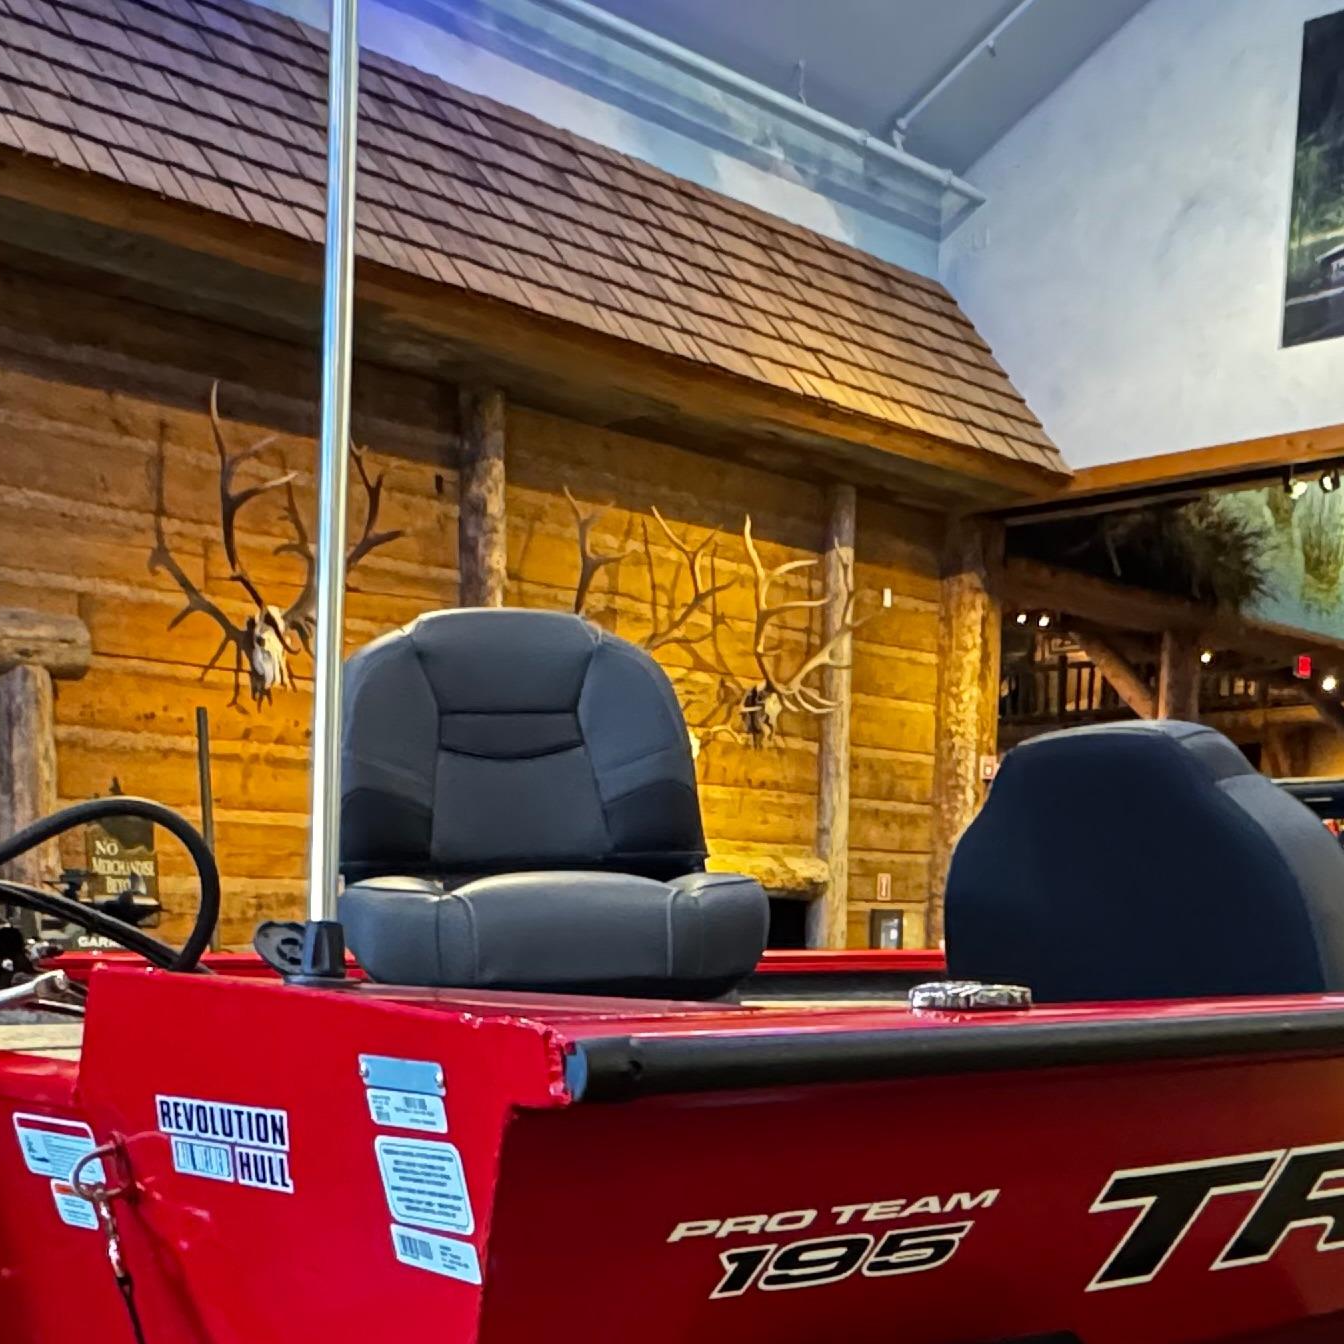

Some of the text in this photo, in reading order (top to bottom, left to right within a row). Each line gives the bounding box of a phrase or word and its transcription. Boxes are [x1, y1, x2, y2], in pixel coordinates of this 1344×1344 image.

[95, 840, 119, 855] NO
[159, 1099, 287, 1146] REVOLUTION
[238, 1151, 290, 1188] HULL
[667, 1189, 1000, 1243] PRO TEAM
[709, 1221, 975, 1299] 195
